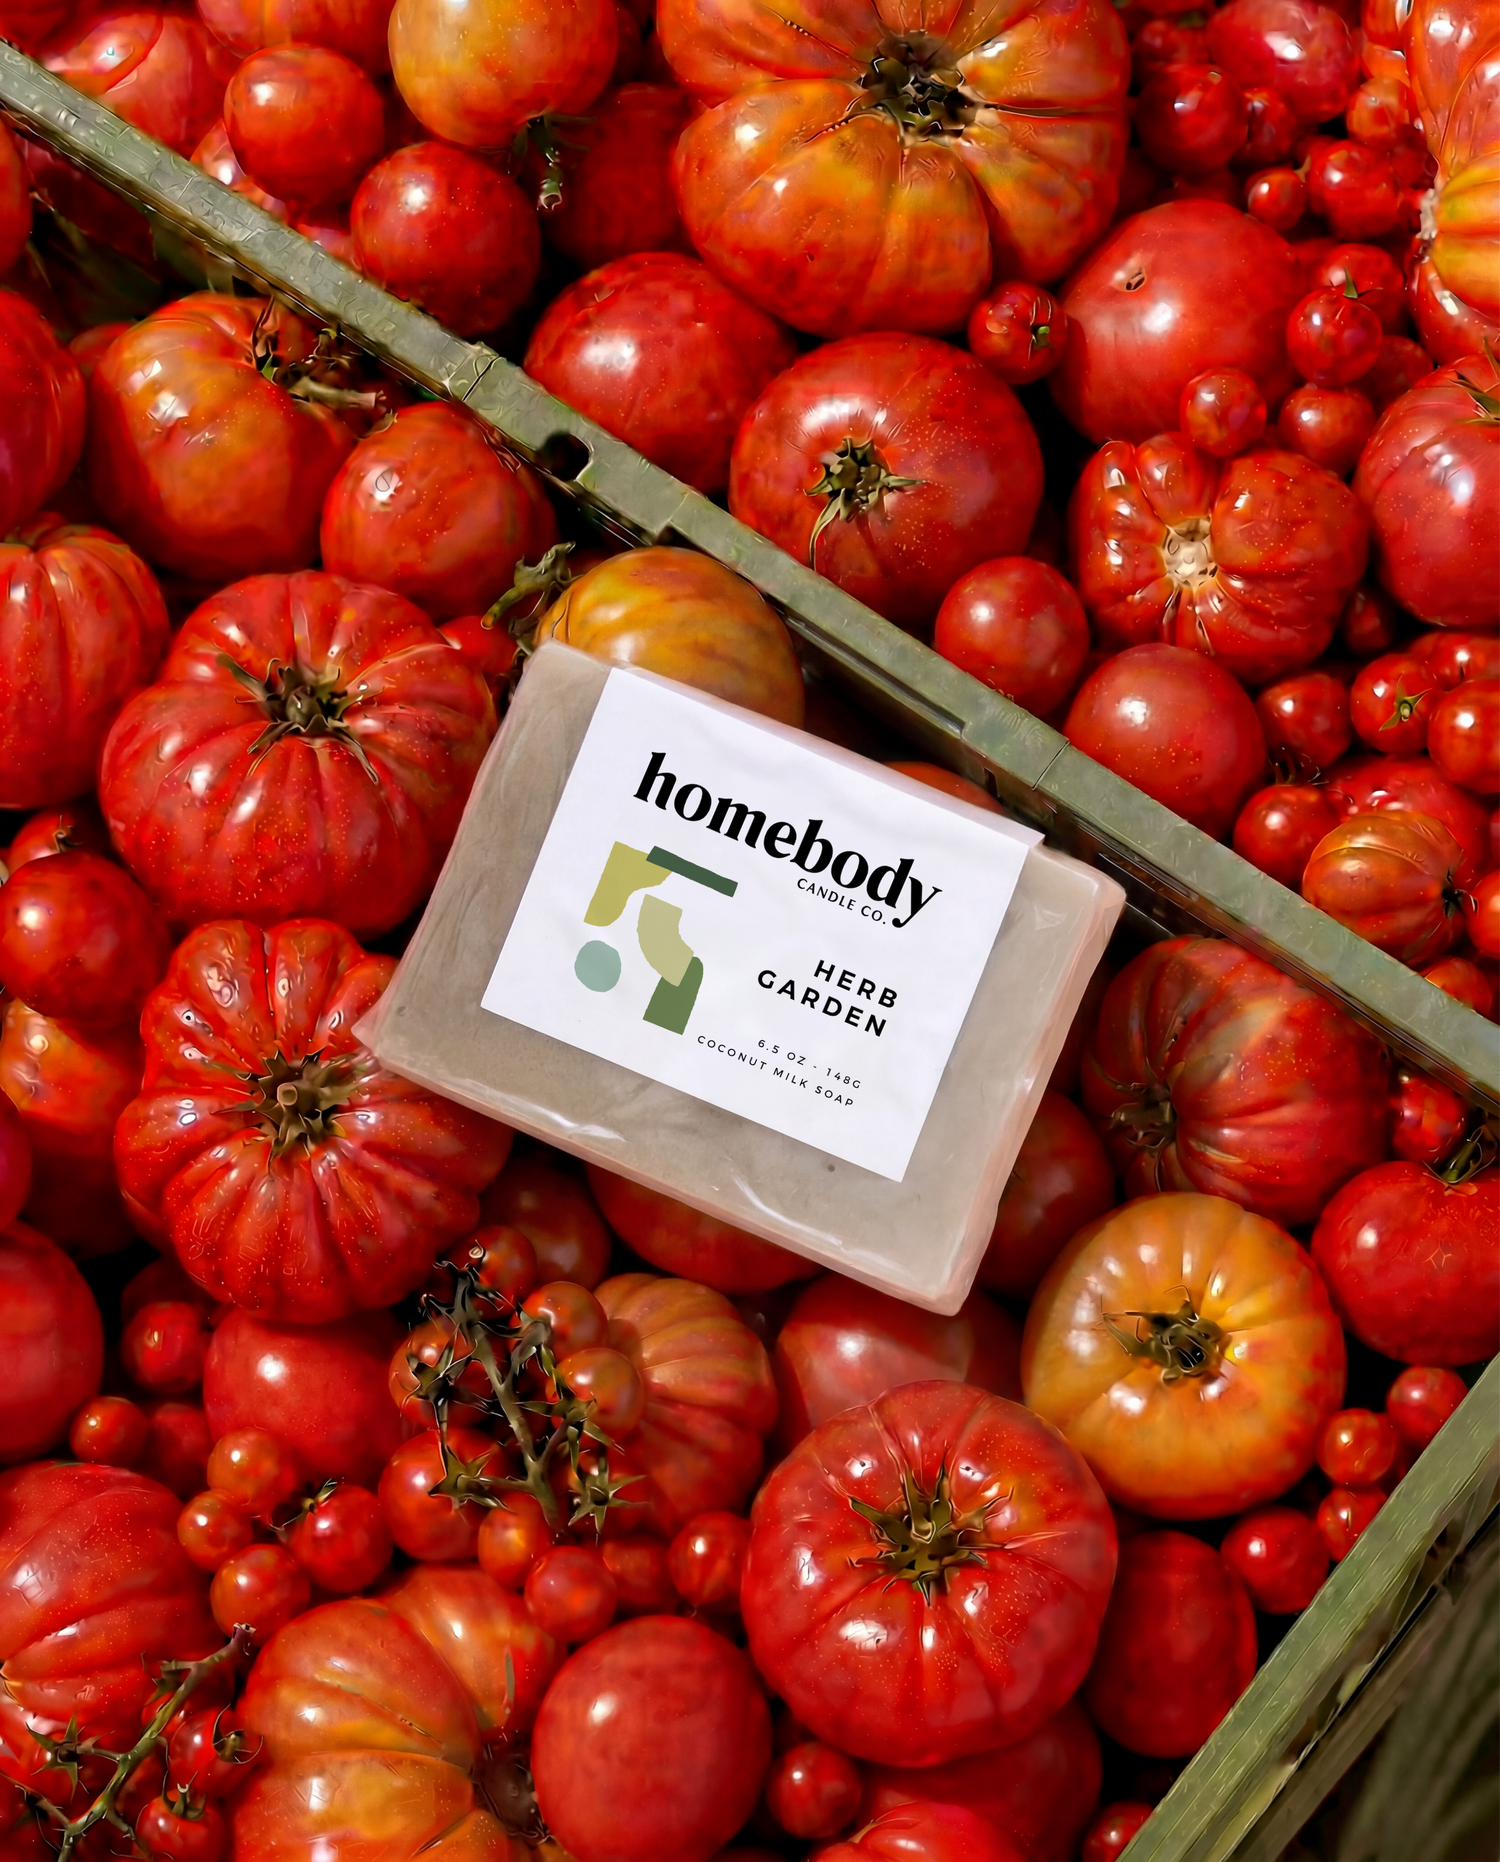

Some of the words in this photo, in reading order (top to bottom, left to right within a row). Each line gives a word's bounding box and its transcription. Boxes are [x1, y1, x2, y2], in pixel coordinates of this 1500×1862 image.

[632, 751, 943, 929] homebody
[796, 878, 857, 911] CANDLE
[860, 905, 887, 926] CO.
[757, 969, 887, 1038] GARDEN
[813, 959, 898, 1009] HERB
[697, 1035, 767, 1070] COCONUT
[772, 1067, 808, 1089] MILK
[814, 1085, 854, 1107] SOAP
[757, 1039, 780, 1054] 6.5
[786, 1051, 806, 1066] OZ
[826, 1067, 861, 1089] 148G
